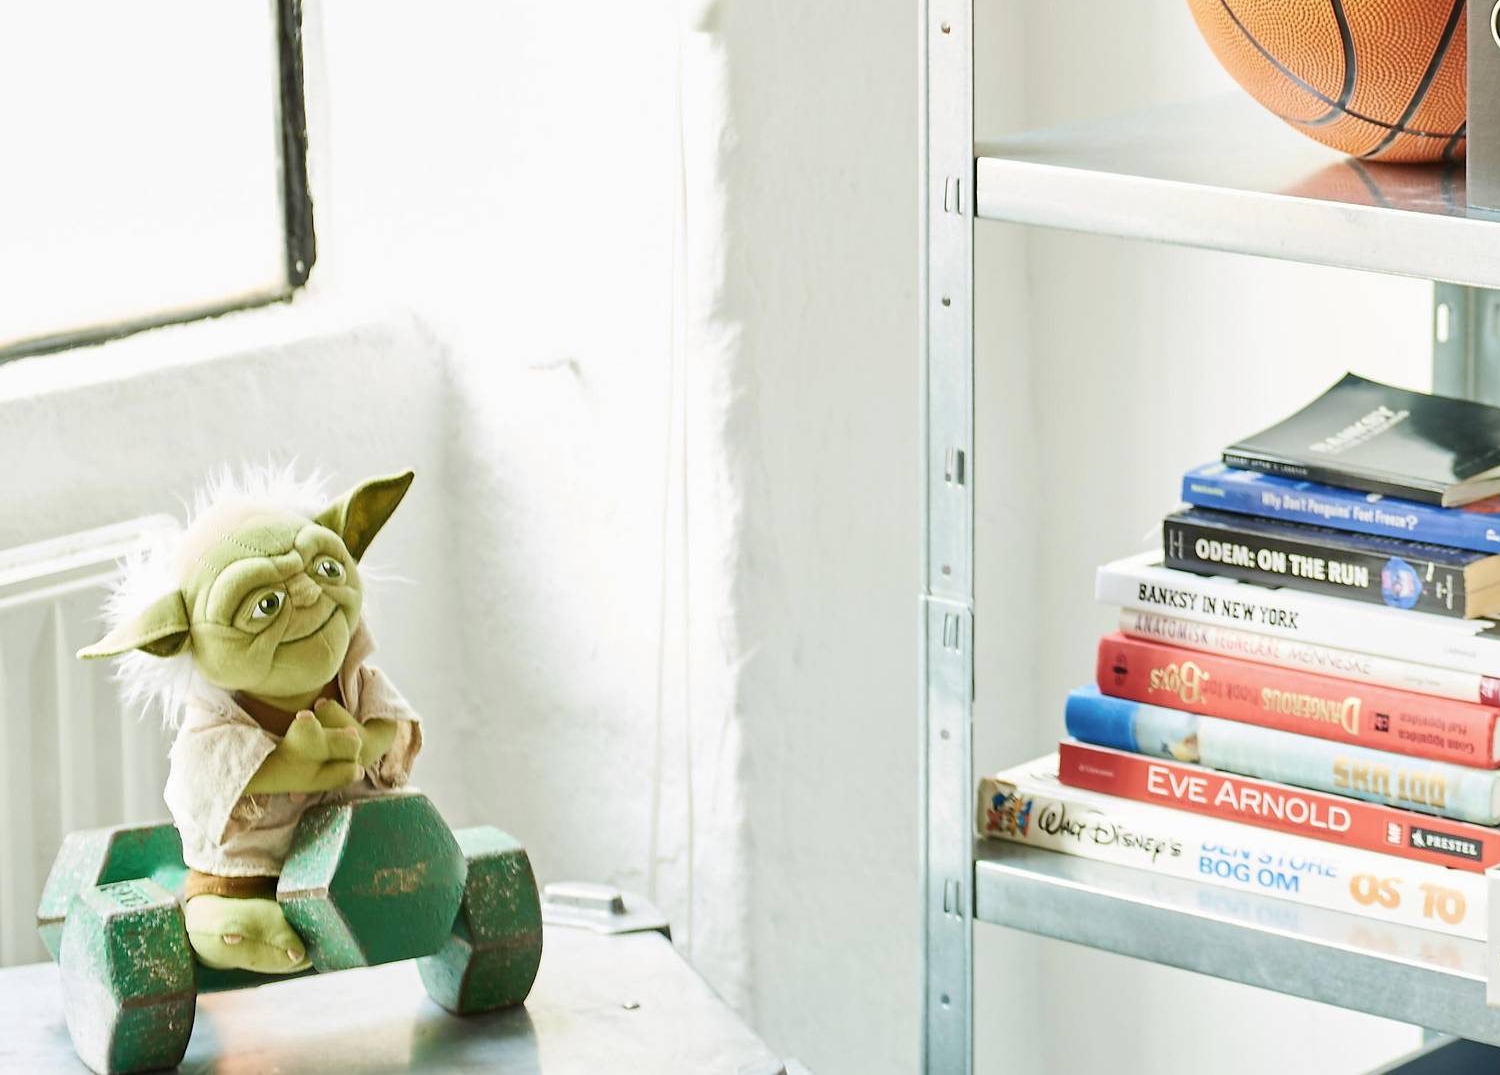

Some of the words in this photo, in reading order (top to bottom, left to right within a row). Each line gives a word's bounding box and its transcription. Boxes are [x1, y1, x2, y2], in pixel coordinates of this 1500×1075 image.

[1194, 537, 1256, 569] ODEM:
[1256, 548, 1286, 574] ON
[1288, 553, 1327, 581] THE
[1328, 560, 1370, 588] RUN
[1138, 583, 1198, 612] BANKSY
[1202, 595, 1217, 616] IN
[1220, 599, 1256, 622] NEW
[1259, 606, 1300, 630] YORK
[1262, 687, 1362, 736] DANGEROUS
[1147, 764, 1208, 804] EVE
[1214, 780, 1352, 832] ARNOLD
[1425, 833, 1478, 856] PRESTEL
[1199, 856, 1250, 883] BOG
[1257, 869, 1300, 894] OM
[1349, 872, 1402, 910] OS
